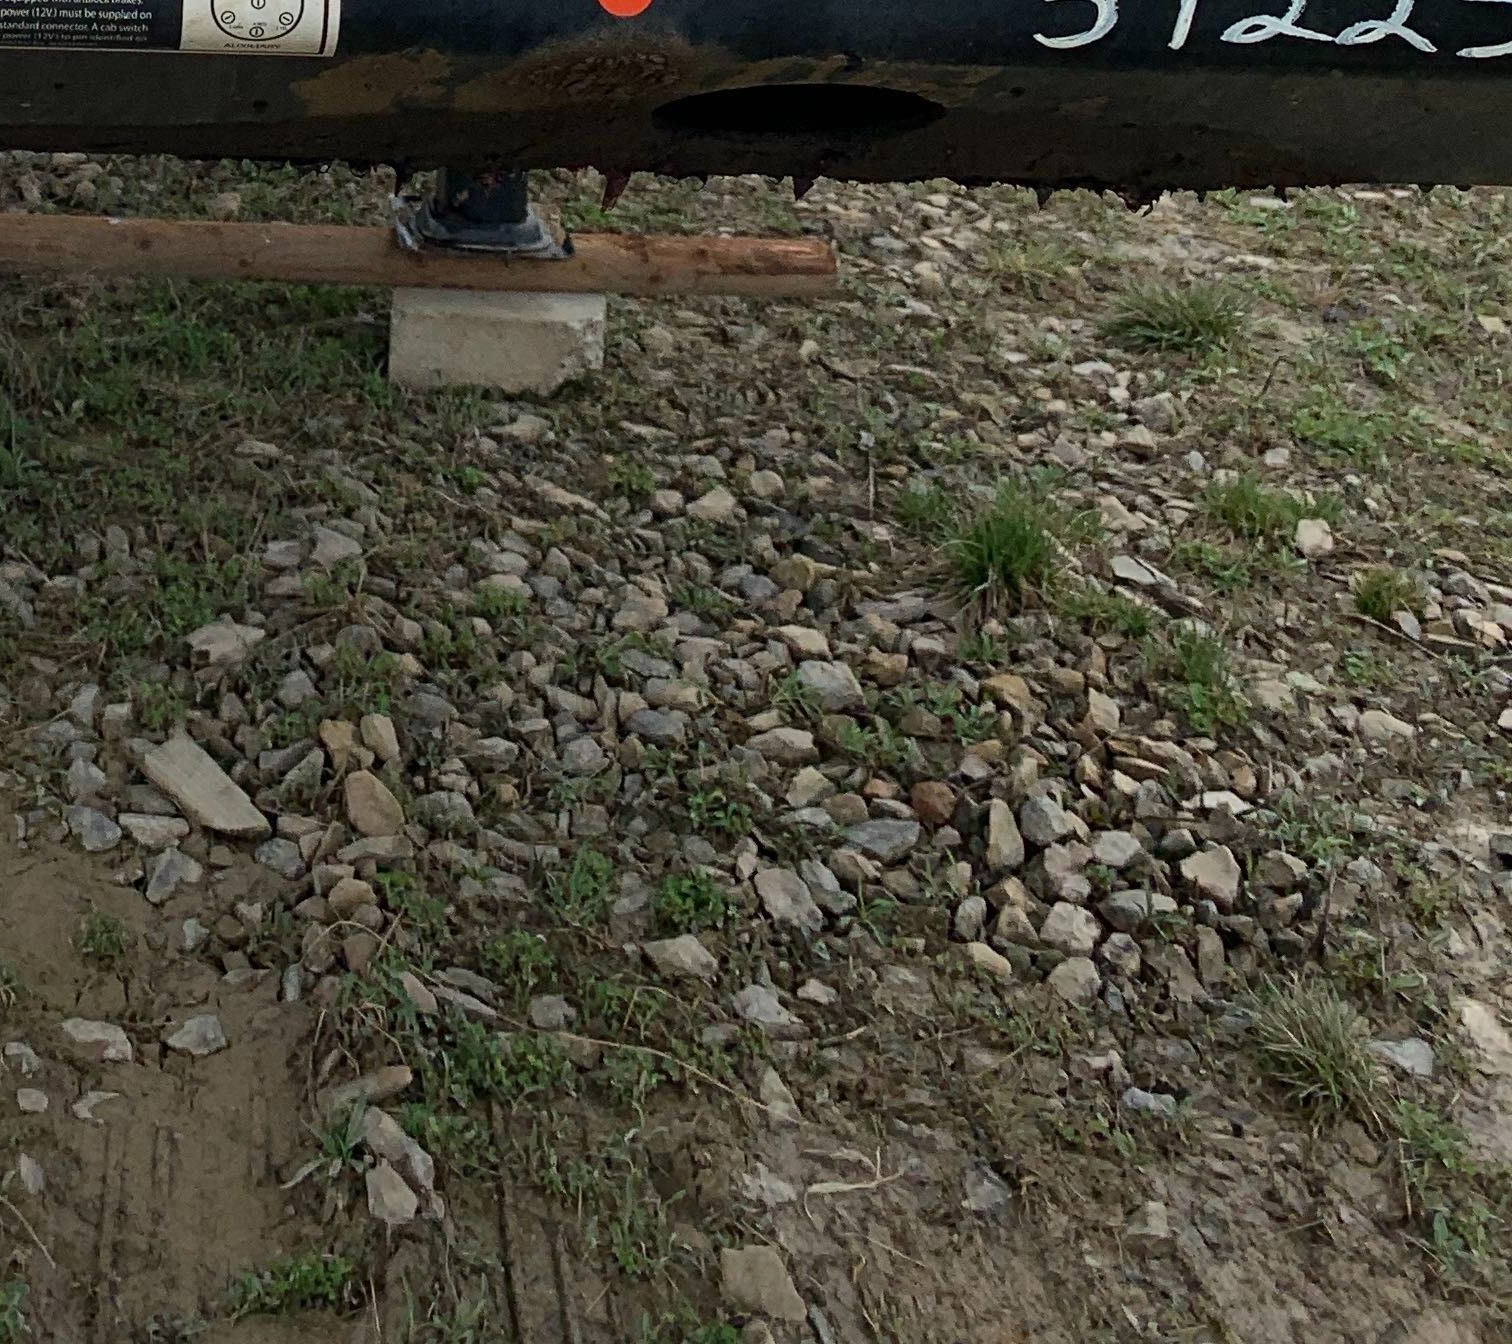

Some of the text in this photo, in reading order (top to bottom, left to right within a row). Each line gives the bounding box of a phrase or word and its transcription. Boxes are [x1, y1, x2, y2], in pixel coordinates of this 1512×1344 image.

[0, 6, 29, 18] power
[59, 8, 81, 19] must
[84, 8, 96, 19] be
[98, 9, 137, 20] supplied
[139, 10, 152, 20] on
